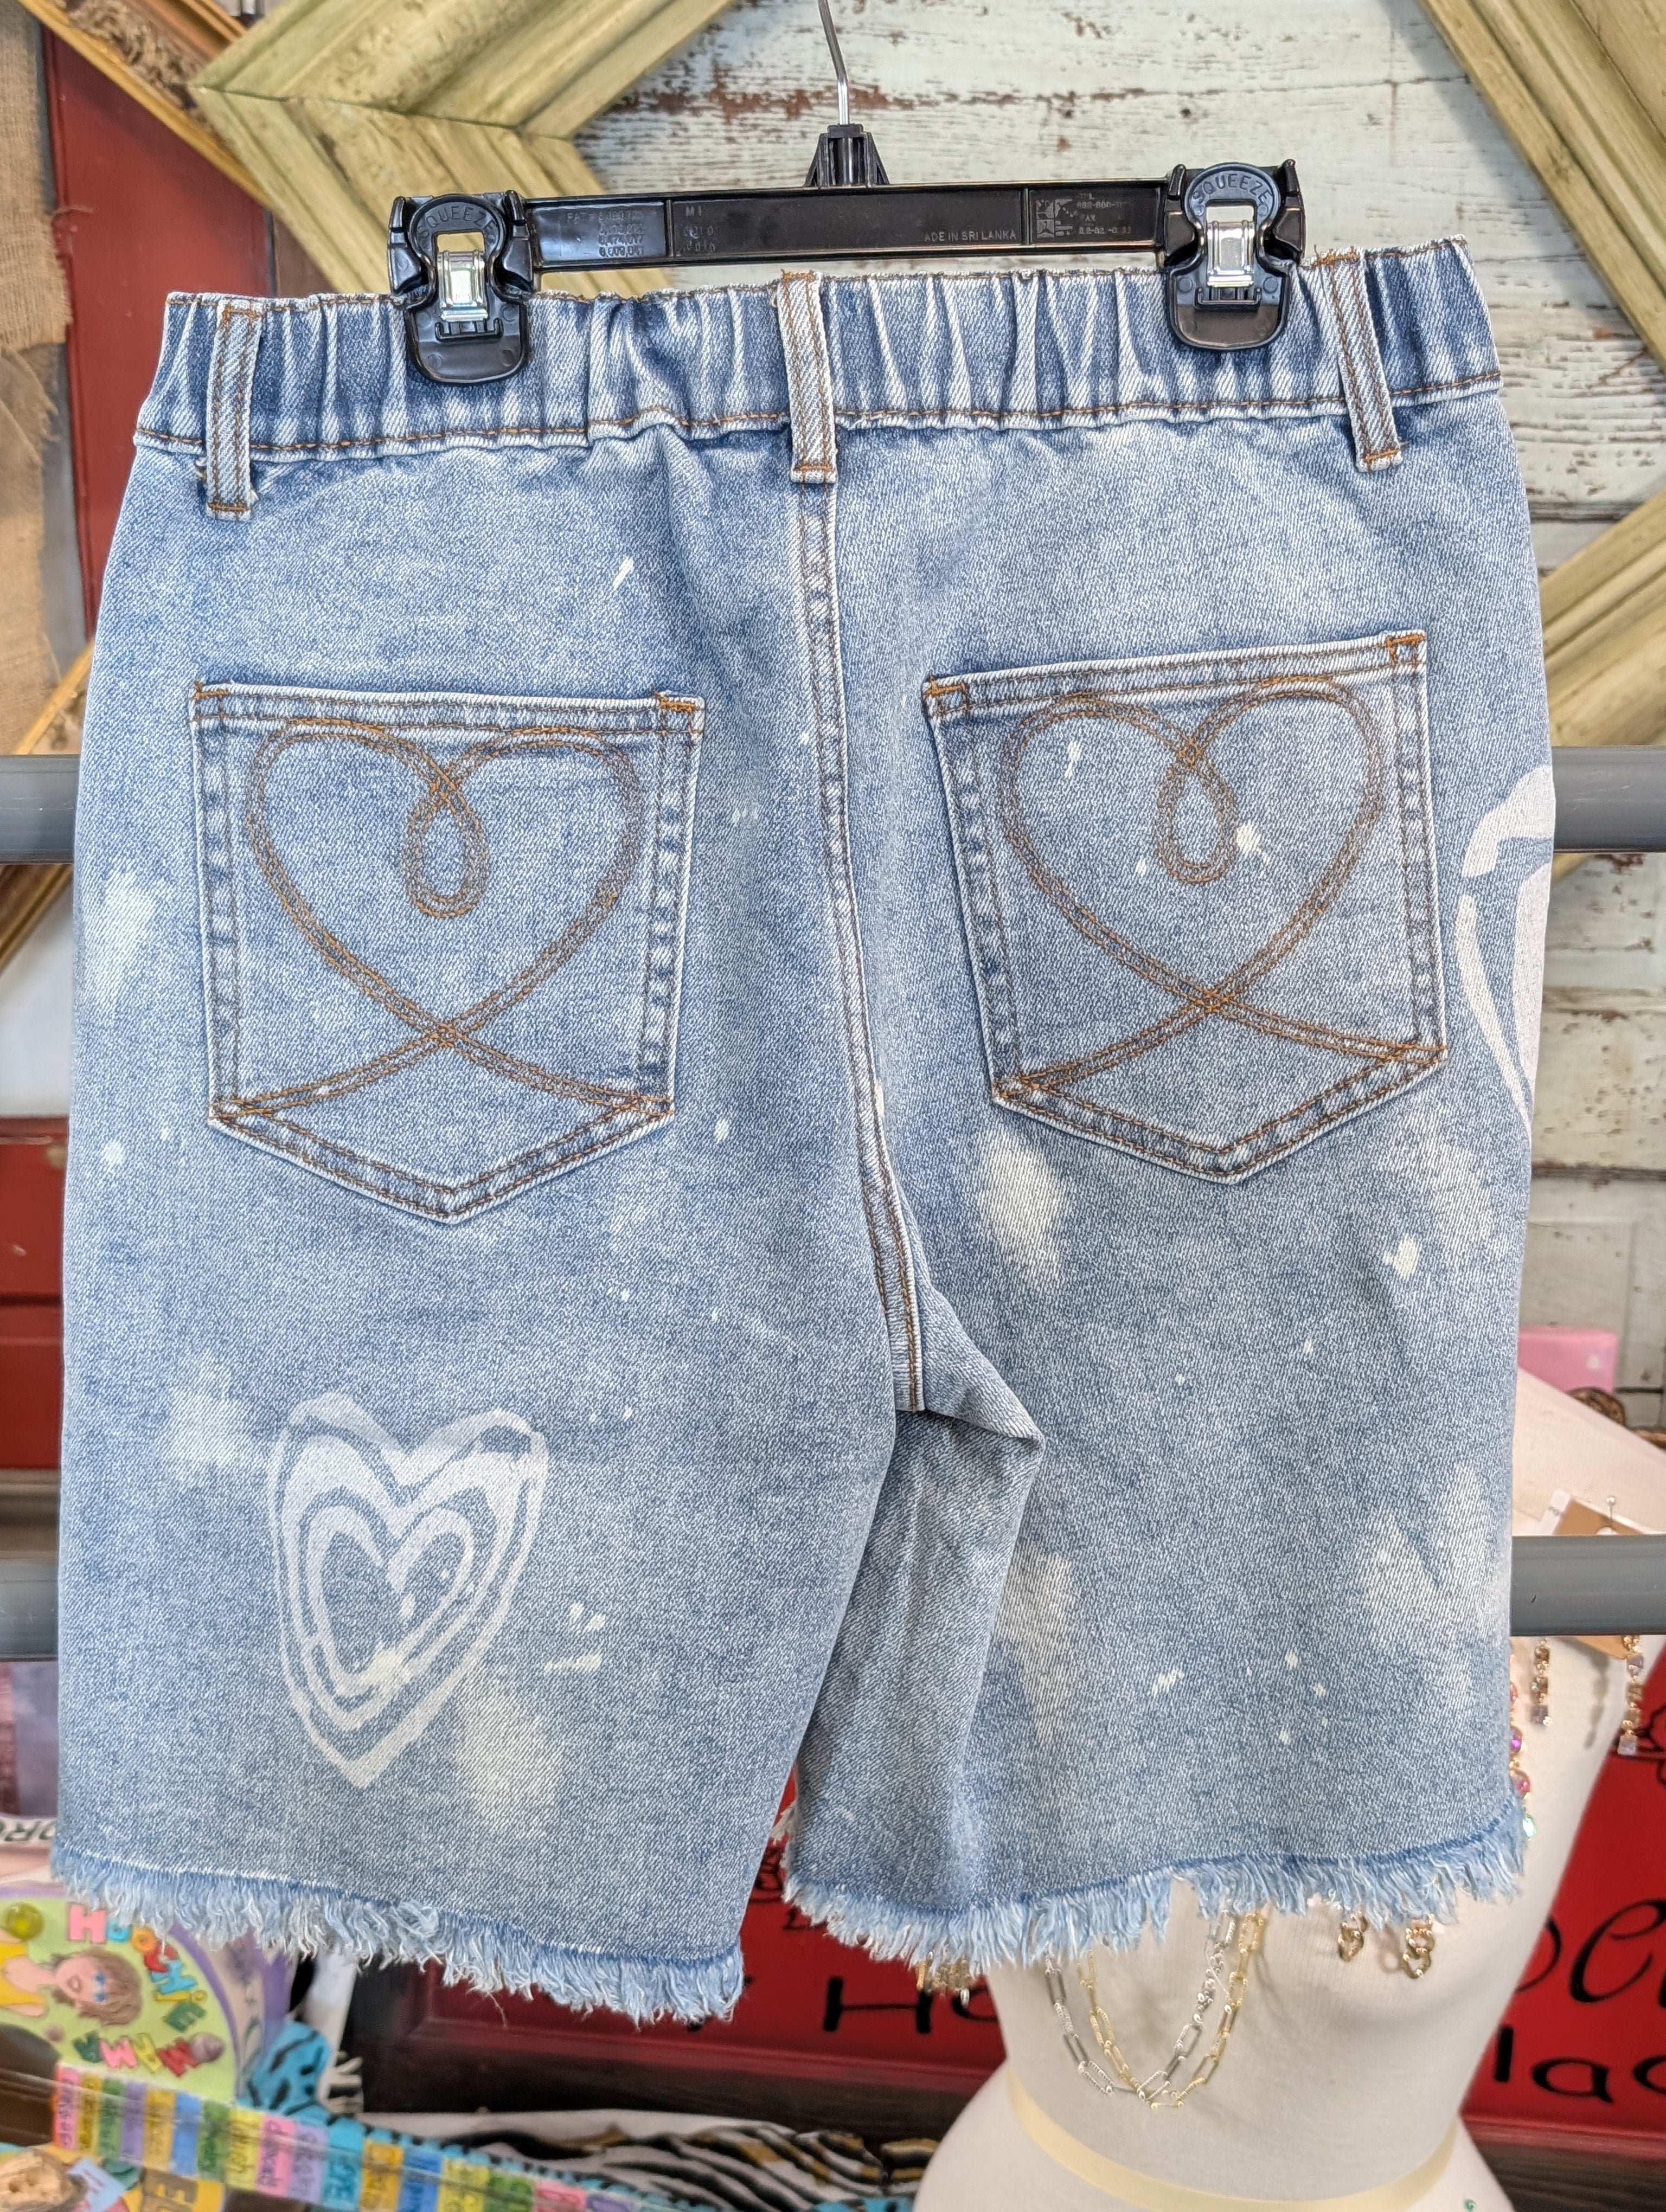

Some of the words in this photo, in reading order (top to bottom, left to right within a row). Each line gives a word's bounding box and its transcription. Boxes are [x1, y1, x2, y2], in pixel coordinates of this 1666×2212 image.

[1193, 172, 1273, 204] SQUEEZE
[921, 231, 945, 242] ADE
[948, 232, 959, 241] IN
[961, 230, 978, 241] SRI
[981, 229, 1017, 241] LANKA
